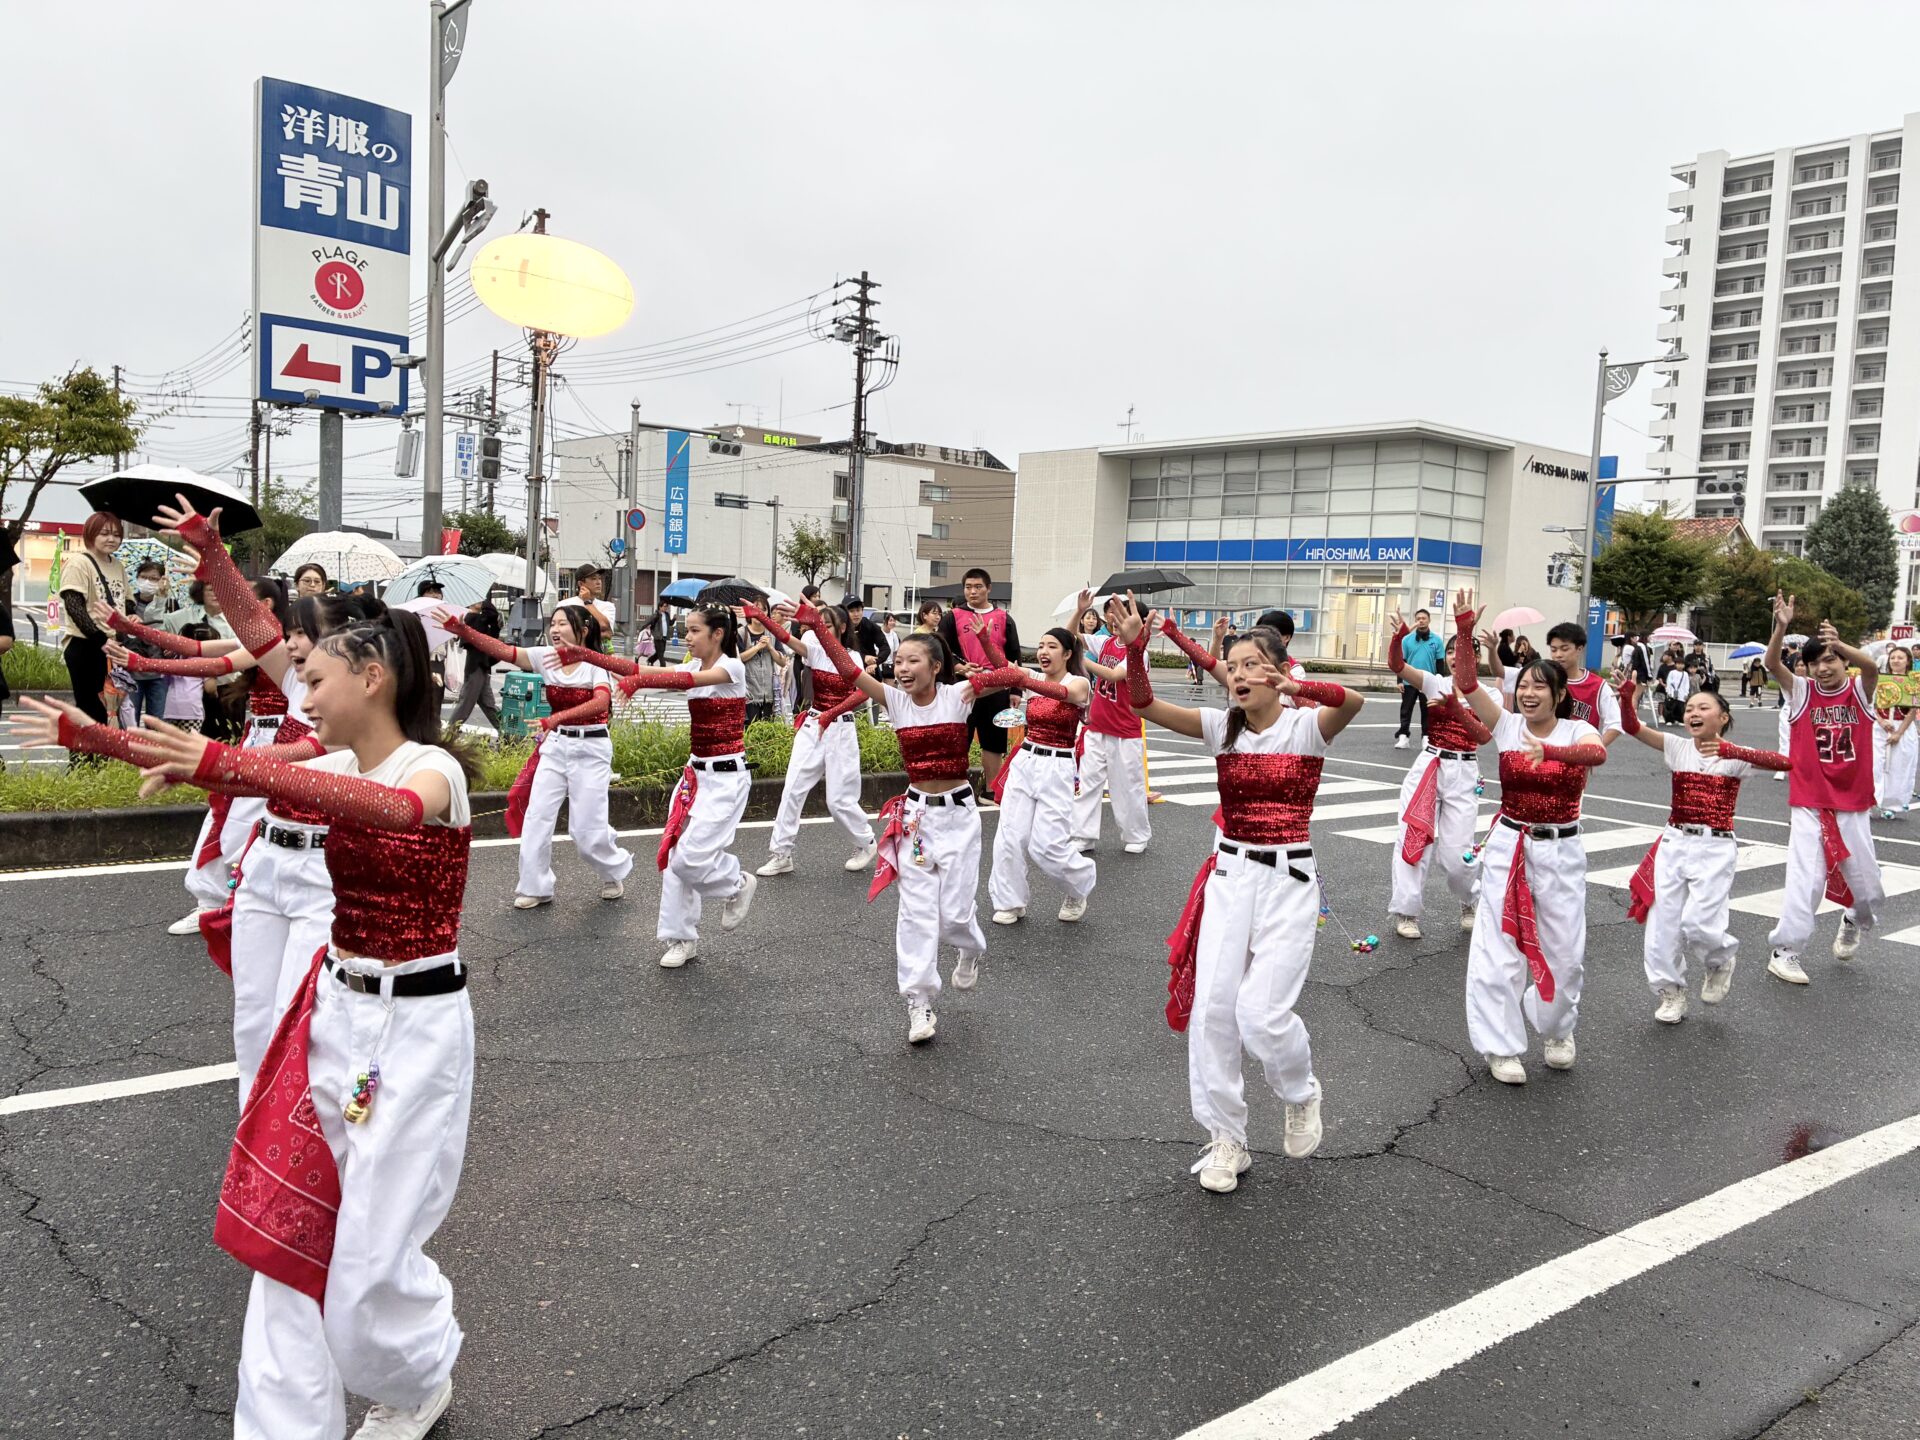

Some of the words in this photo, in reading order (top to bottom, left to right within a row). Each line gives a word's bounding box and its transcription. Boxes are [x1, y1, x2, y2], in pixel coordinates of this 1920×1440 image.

[280, 103, 398, 164] 洋服の
[276, 153, 399, 231] 青山
[311, 246, 369, 272] PLAGE
[310, 294, 336, 316] BARBER
[343, 302, 368, 319] BEAUTY
[351, 344, 393, 395] P
[1531, 460, 1569, 480] HIROSHIMA
[1570, 468, 1589, 482] BANK
[668, 486, 685, 548] 広島銀行
[1305, 547, 1371, 560] HIROSHIMA
[1377, 547, 1412, 560] BANK
[1899, 629, 1913, 639] IN
[1815, 725, 1856, 763] 24
